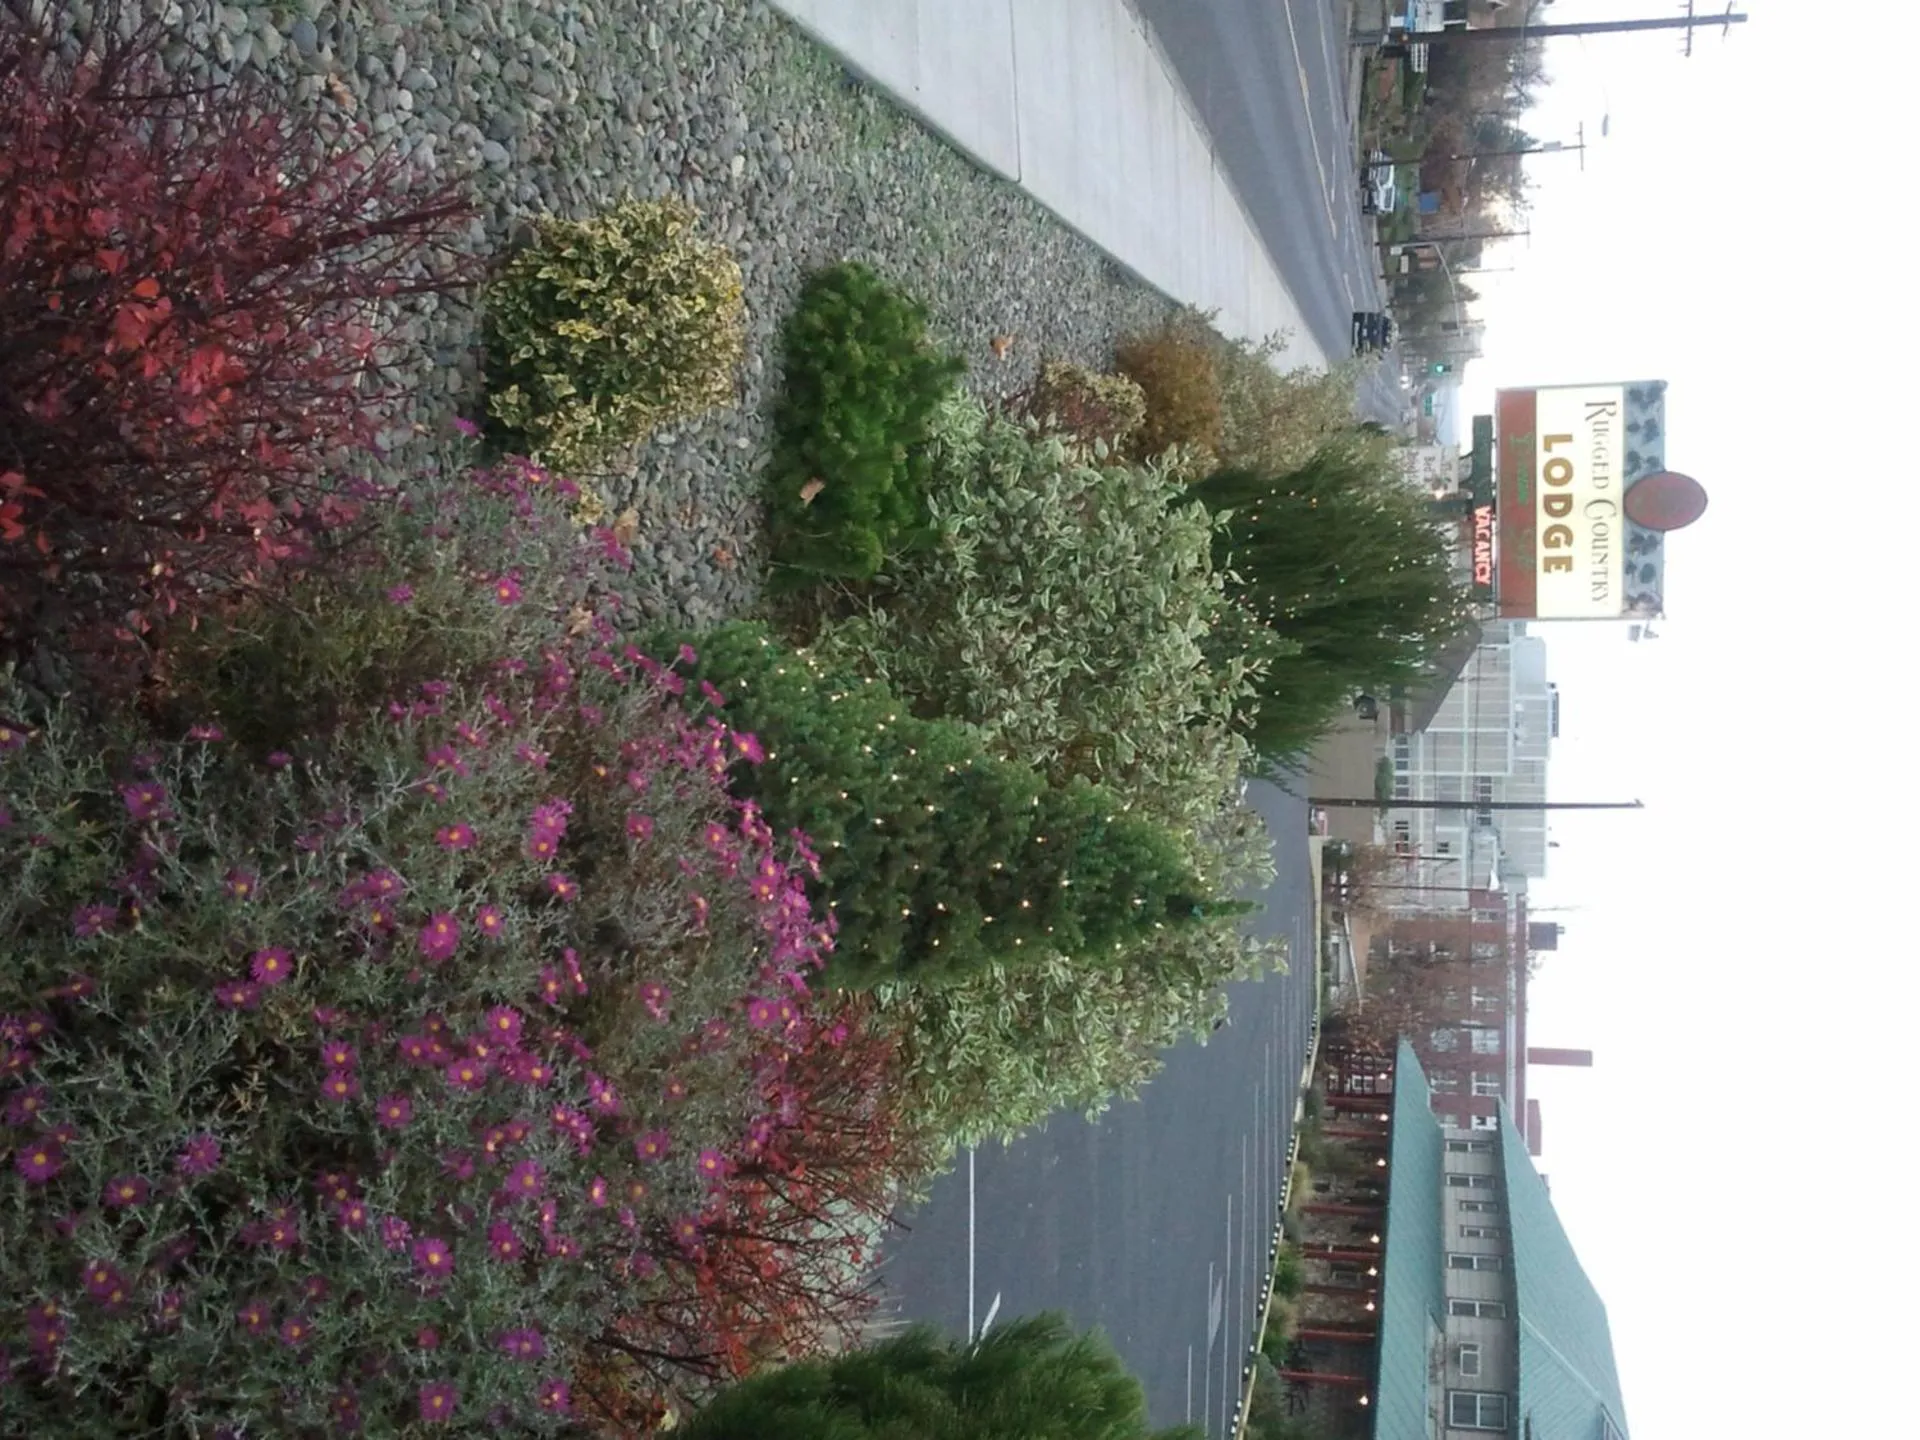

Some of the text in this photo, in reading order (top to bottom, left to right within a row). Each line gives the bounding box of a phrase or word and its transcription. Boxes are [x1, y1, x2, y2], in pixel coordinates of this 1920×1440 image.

[1474, 505, 1492, 584] VACANCY
[1542, 433, 1574, 574] LODGE
[1583, 400, 1618, 603] RUGGED COUNTRY
